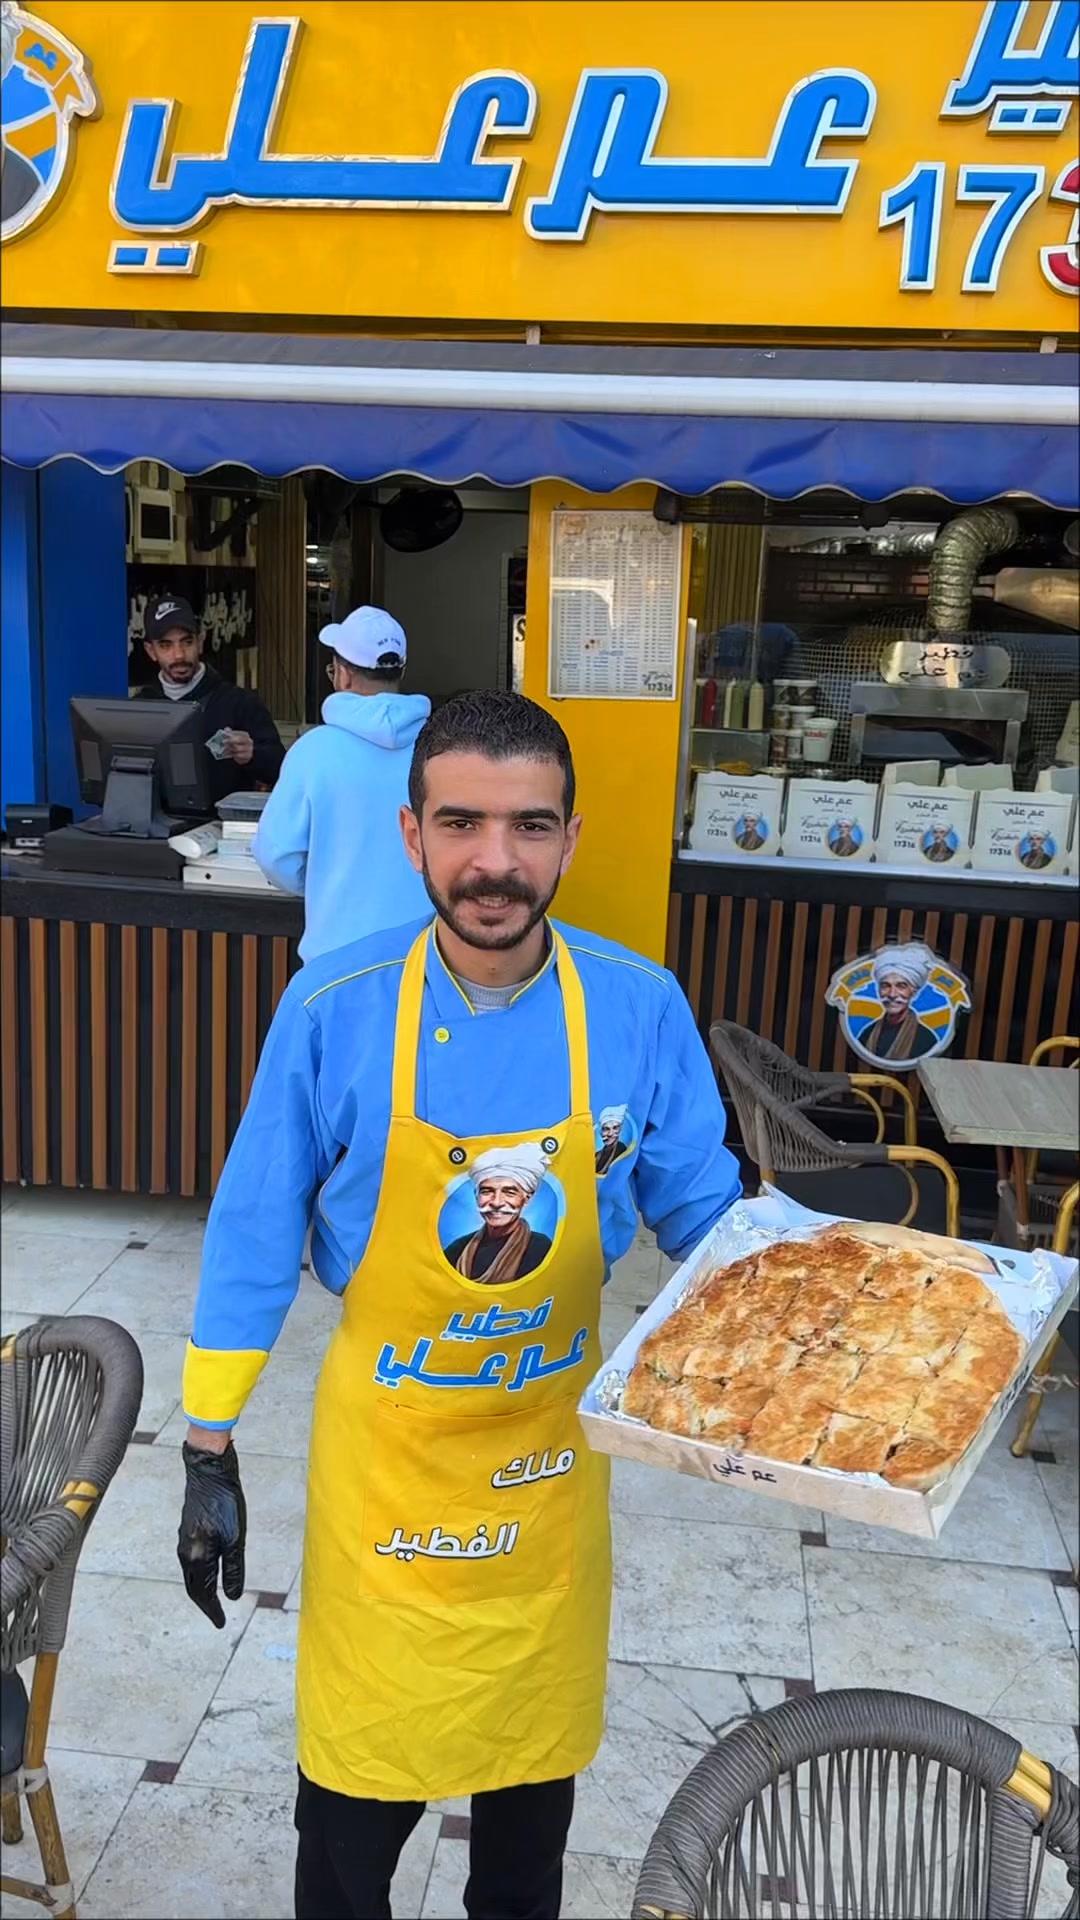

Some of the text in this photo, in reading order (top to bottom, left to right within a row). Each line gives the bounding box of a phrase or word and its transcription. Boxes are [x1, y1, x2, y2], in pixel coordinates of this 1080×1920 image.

[108, 17, 877, 275] عم علي
[439, 1296, 555, 1342] فطير
[373, 1327, 589, 1392] عم علي
[491, 1447, 576, 1488] ملك
[374, 1520, 521, 1562] الفطير
